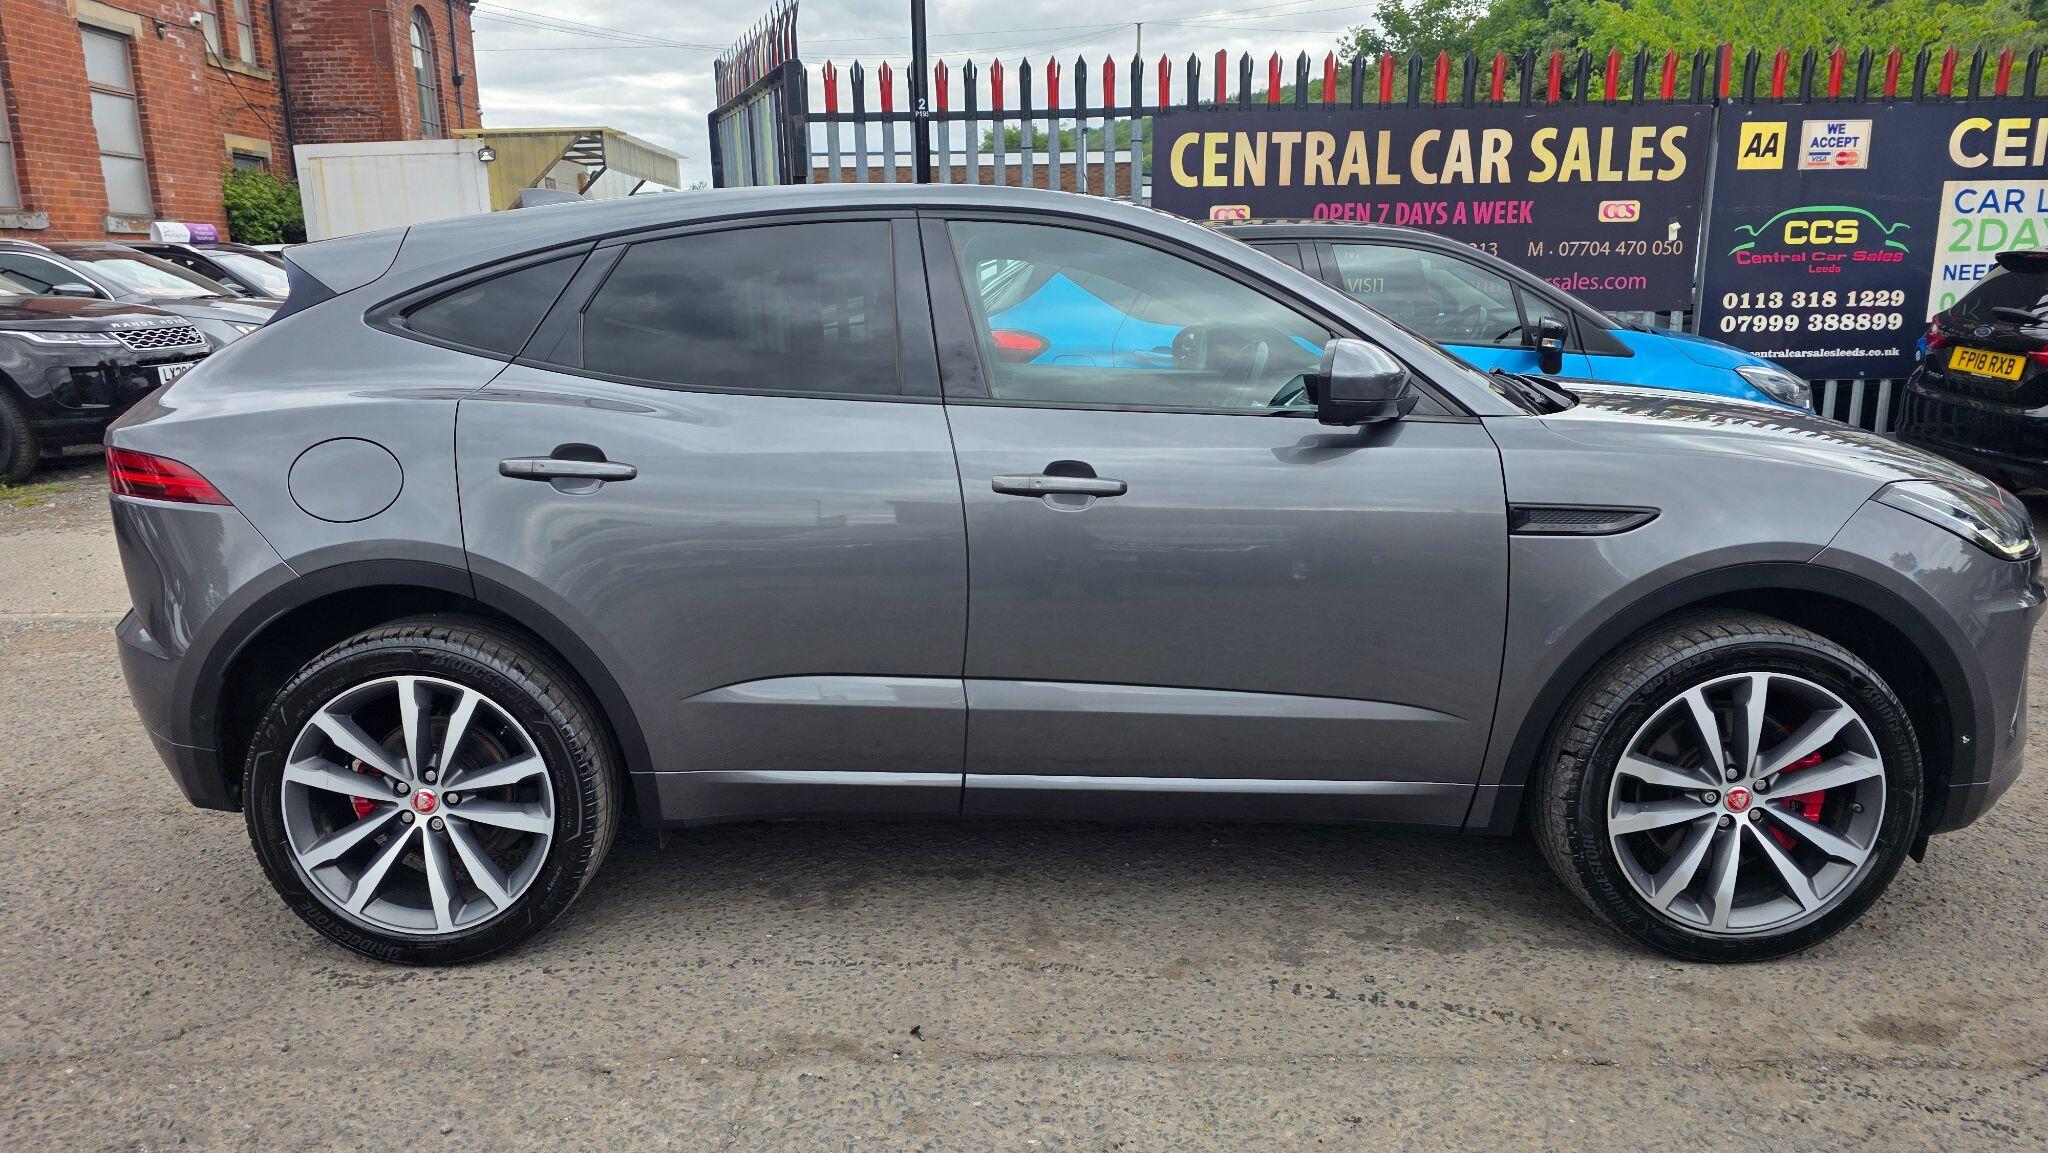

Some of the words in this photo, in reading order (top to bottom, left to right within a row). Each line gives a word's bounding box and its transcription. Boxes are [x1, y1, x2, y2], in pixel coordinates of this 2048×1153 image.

[918, 98, 926, 110] 2
[1827, 123, 1847, 135] WE
[1743, 132, 1779, 158] AA
[1810, 136, 1860, 148] ACCEPT
[1170, 131, 1401, 188] CENTRAL
[1410, 129, 1513, 185] CAR
[1528, 126, 1688, 183] SALES
[1603, 203, 1635, 219] CCS
[1954, 188, 2026, 214] CAR
[1314, 203, 1371, 222] OPEN
[1377, 203, 1390, 224] 7
[1395, 201, 1448, 225] DAYS
[1452, 201, 1467, 225] A
[1473, 200, 1535, 225] WEEK
[1783, 219, 1859, 245] CCS
[1948, 217, 2048, 252] 2DA
[1527, 241, 1543, 257] M
[1558, 241, 1610, 256] 07704
[1615, 240, 1647, 256] 470
[1652, 240, 1683, 255] 050
[1736, 250, 1806, 265] Central
[1811, 251, 1848, 262] Car
[1852, 250, 1904, 262] Sales
[1808, 264, 1841, 273] Leeds
[1722, 292, 1783, 309] 0113
[1791, 291, 1837, 307] 318
[1846, 289, 1905, 307] 1229
[1720, 314, 1800, 333] 07999
[1807, 312, 1903, 332] 388899
[1957, 350, 1988, 372] FP18
[1987, 355, 2016, 375] RXB
